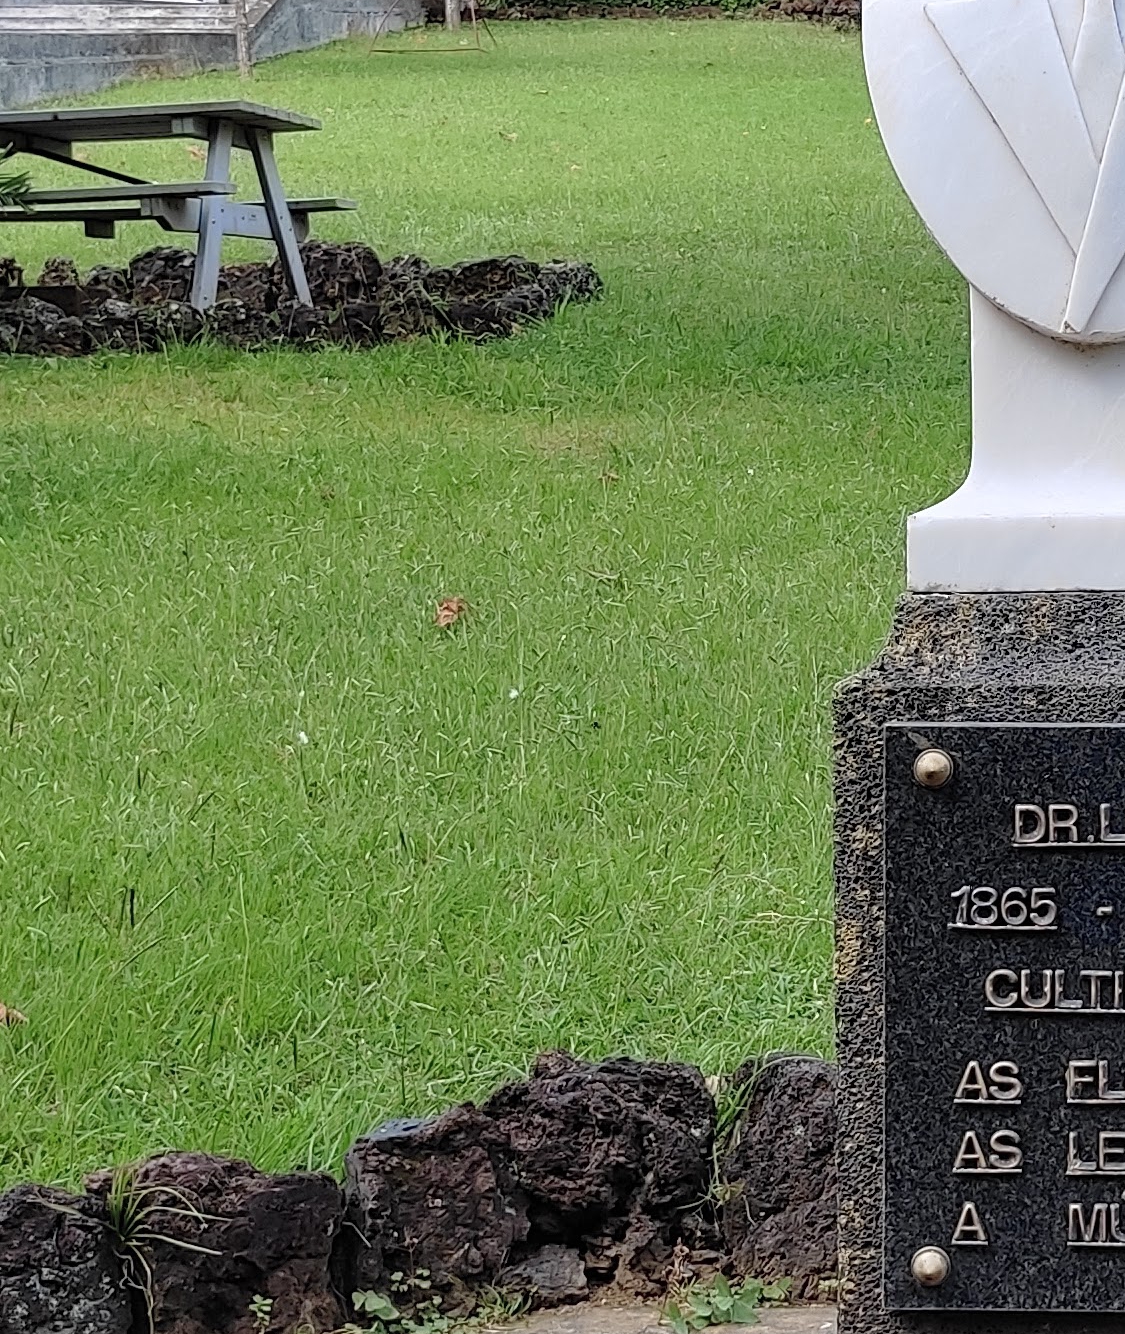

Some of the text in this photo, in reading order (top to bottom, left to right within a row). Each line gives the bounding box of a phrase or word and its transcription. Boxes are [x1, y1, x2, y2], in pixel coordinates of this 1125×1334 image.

[950, 886, 1057, 927] 1865
[955, 1060, 1023, 1101] AS
[954, 1129, 1023, 1170] AS
[953, 1201, 988, 1243] A
